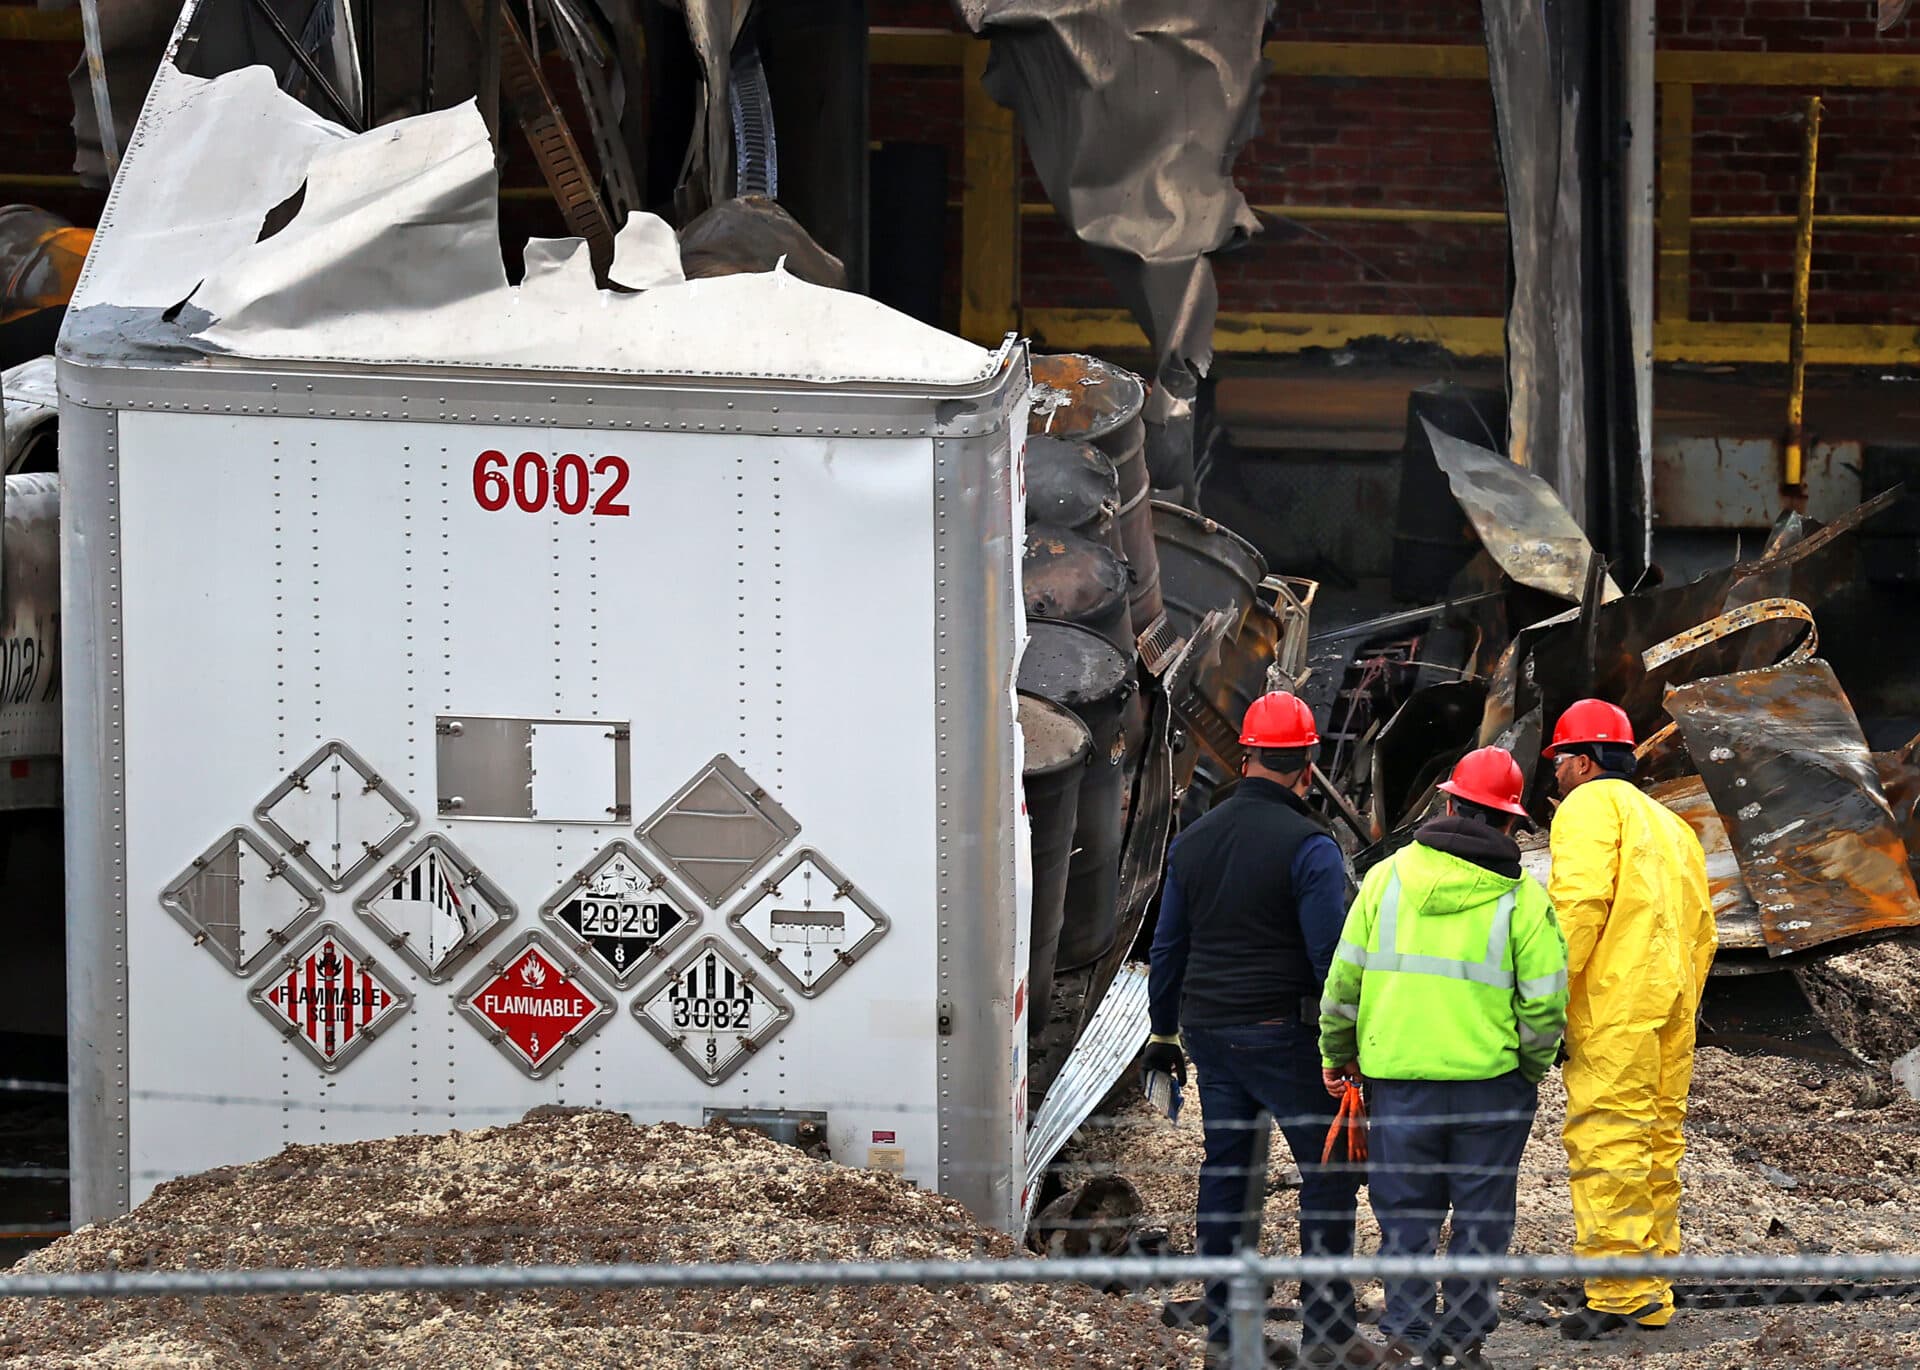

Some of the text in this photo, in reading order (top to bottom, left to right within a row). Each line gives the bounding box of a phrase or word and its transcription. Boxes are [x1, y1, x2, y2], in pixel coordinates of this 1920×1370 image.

[472, 449, 630, 516] 6002
[582, 902, 658, 934] 2920
[614, 948, 625, 963] 8
[279, 985, 381, 1007] FLAMMABLE
[484, 994, 584, 1018] FLAMMABLE
[309, 1007, 350, 1023] SOLID
[673, 997, 749, 1029] 3082
[530, 1037, 540, 1053] 3
[705, 1043, 717, 1058] 9
